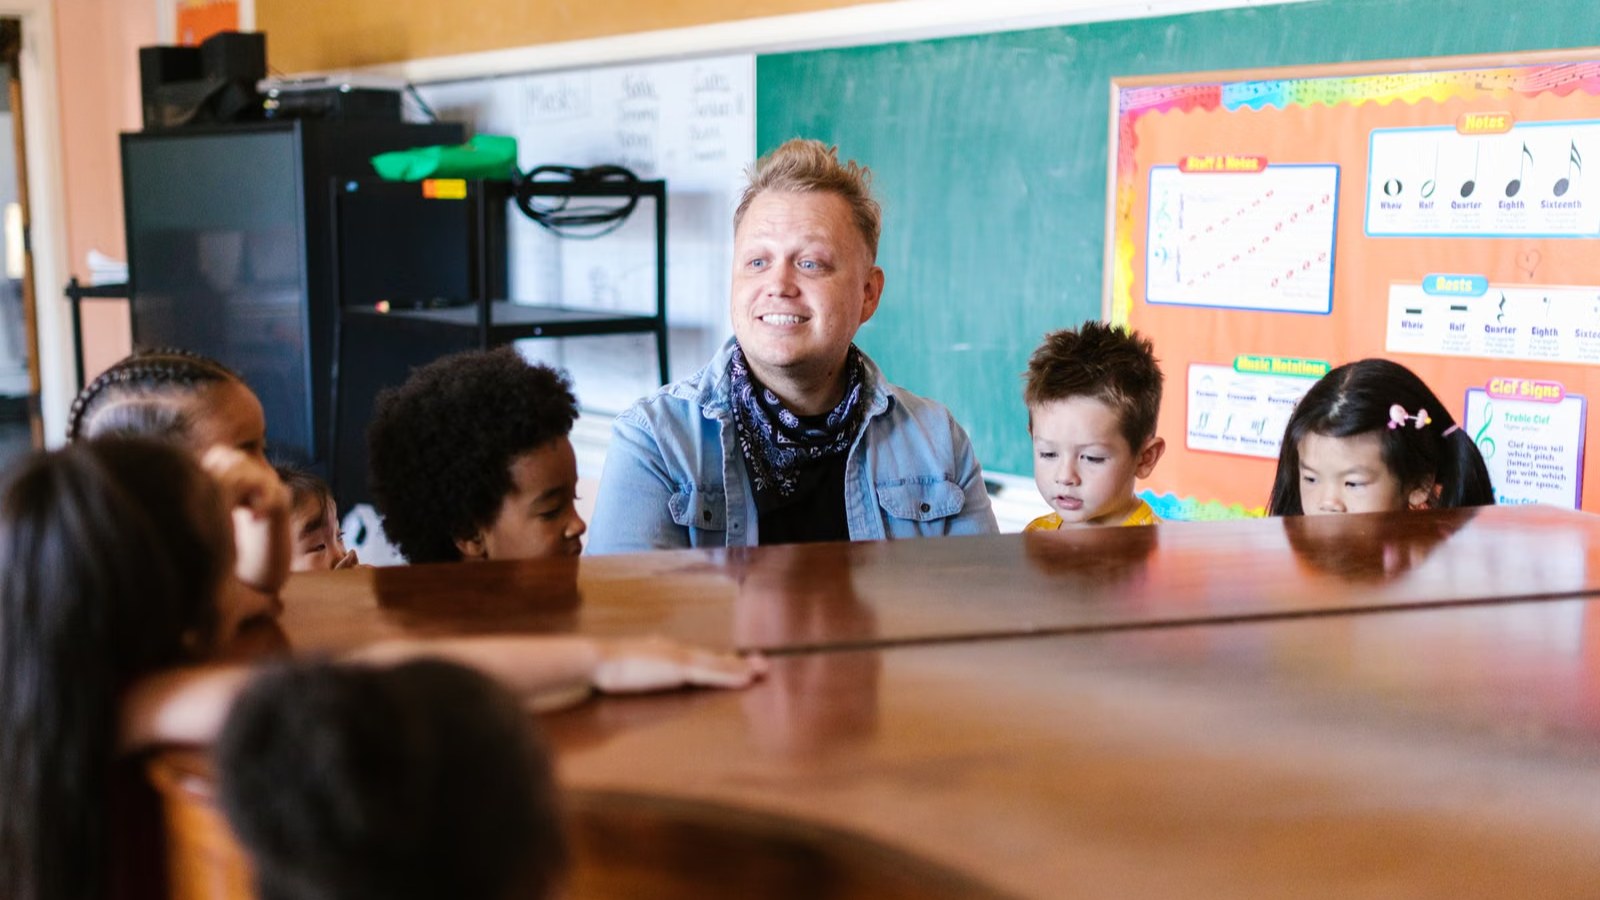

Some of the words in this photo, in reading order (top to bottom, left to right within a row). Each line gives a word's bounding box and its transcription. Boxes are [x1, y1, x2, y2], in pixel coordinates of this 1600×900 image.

[1464, 115, 1505, 130] Notes
[1225, 155, 1259, 170] Notes
[1418, 201, 1434, 209] Half
[1450, 200, 1482, 210] Quarter
[1498, 200, 1525, 211] Eighth
[1540, 200, 1582, 209] Sixteenth
[1436, 276, 1472, 292] Rests
[1401, 319, 1423, 329] Whole
[1449, 321, 1465, 331] Half
[1484, 324, 1516, 335] Quarter
[1531, 326, 1558, 338] Eighth
[1272, 357, 1327, 376] Notations
[1490, 379, 1520, 394] Clef
[1521, 381, 1560, 399] Signs
[1504, 412, 1531, 423] Treble
[1533, 414, 1550, 425] Clef
[1508, 440, 1524, 449] Clef
[1527, 443, 1547, 453] signs
[1550, 445, 1563, 453] tell
[1507, 450, 1531, 459] which
[1534, 452, 1554, 461] pitch
[1506, 459, 1533, 469] (letter)
[1536, 463, 1563, 471] names
[1506, 470, 1517, 478] go
[1520, 470, 1538, 478] with
[1541, 472, 1566, 482] which
[1506, 476, 1520, 485] line
